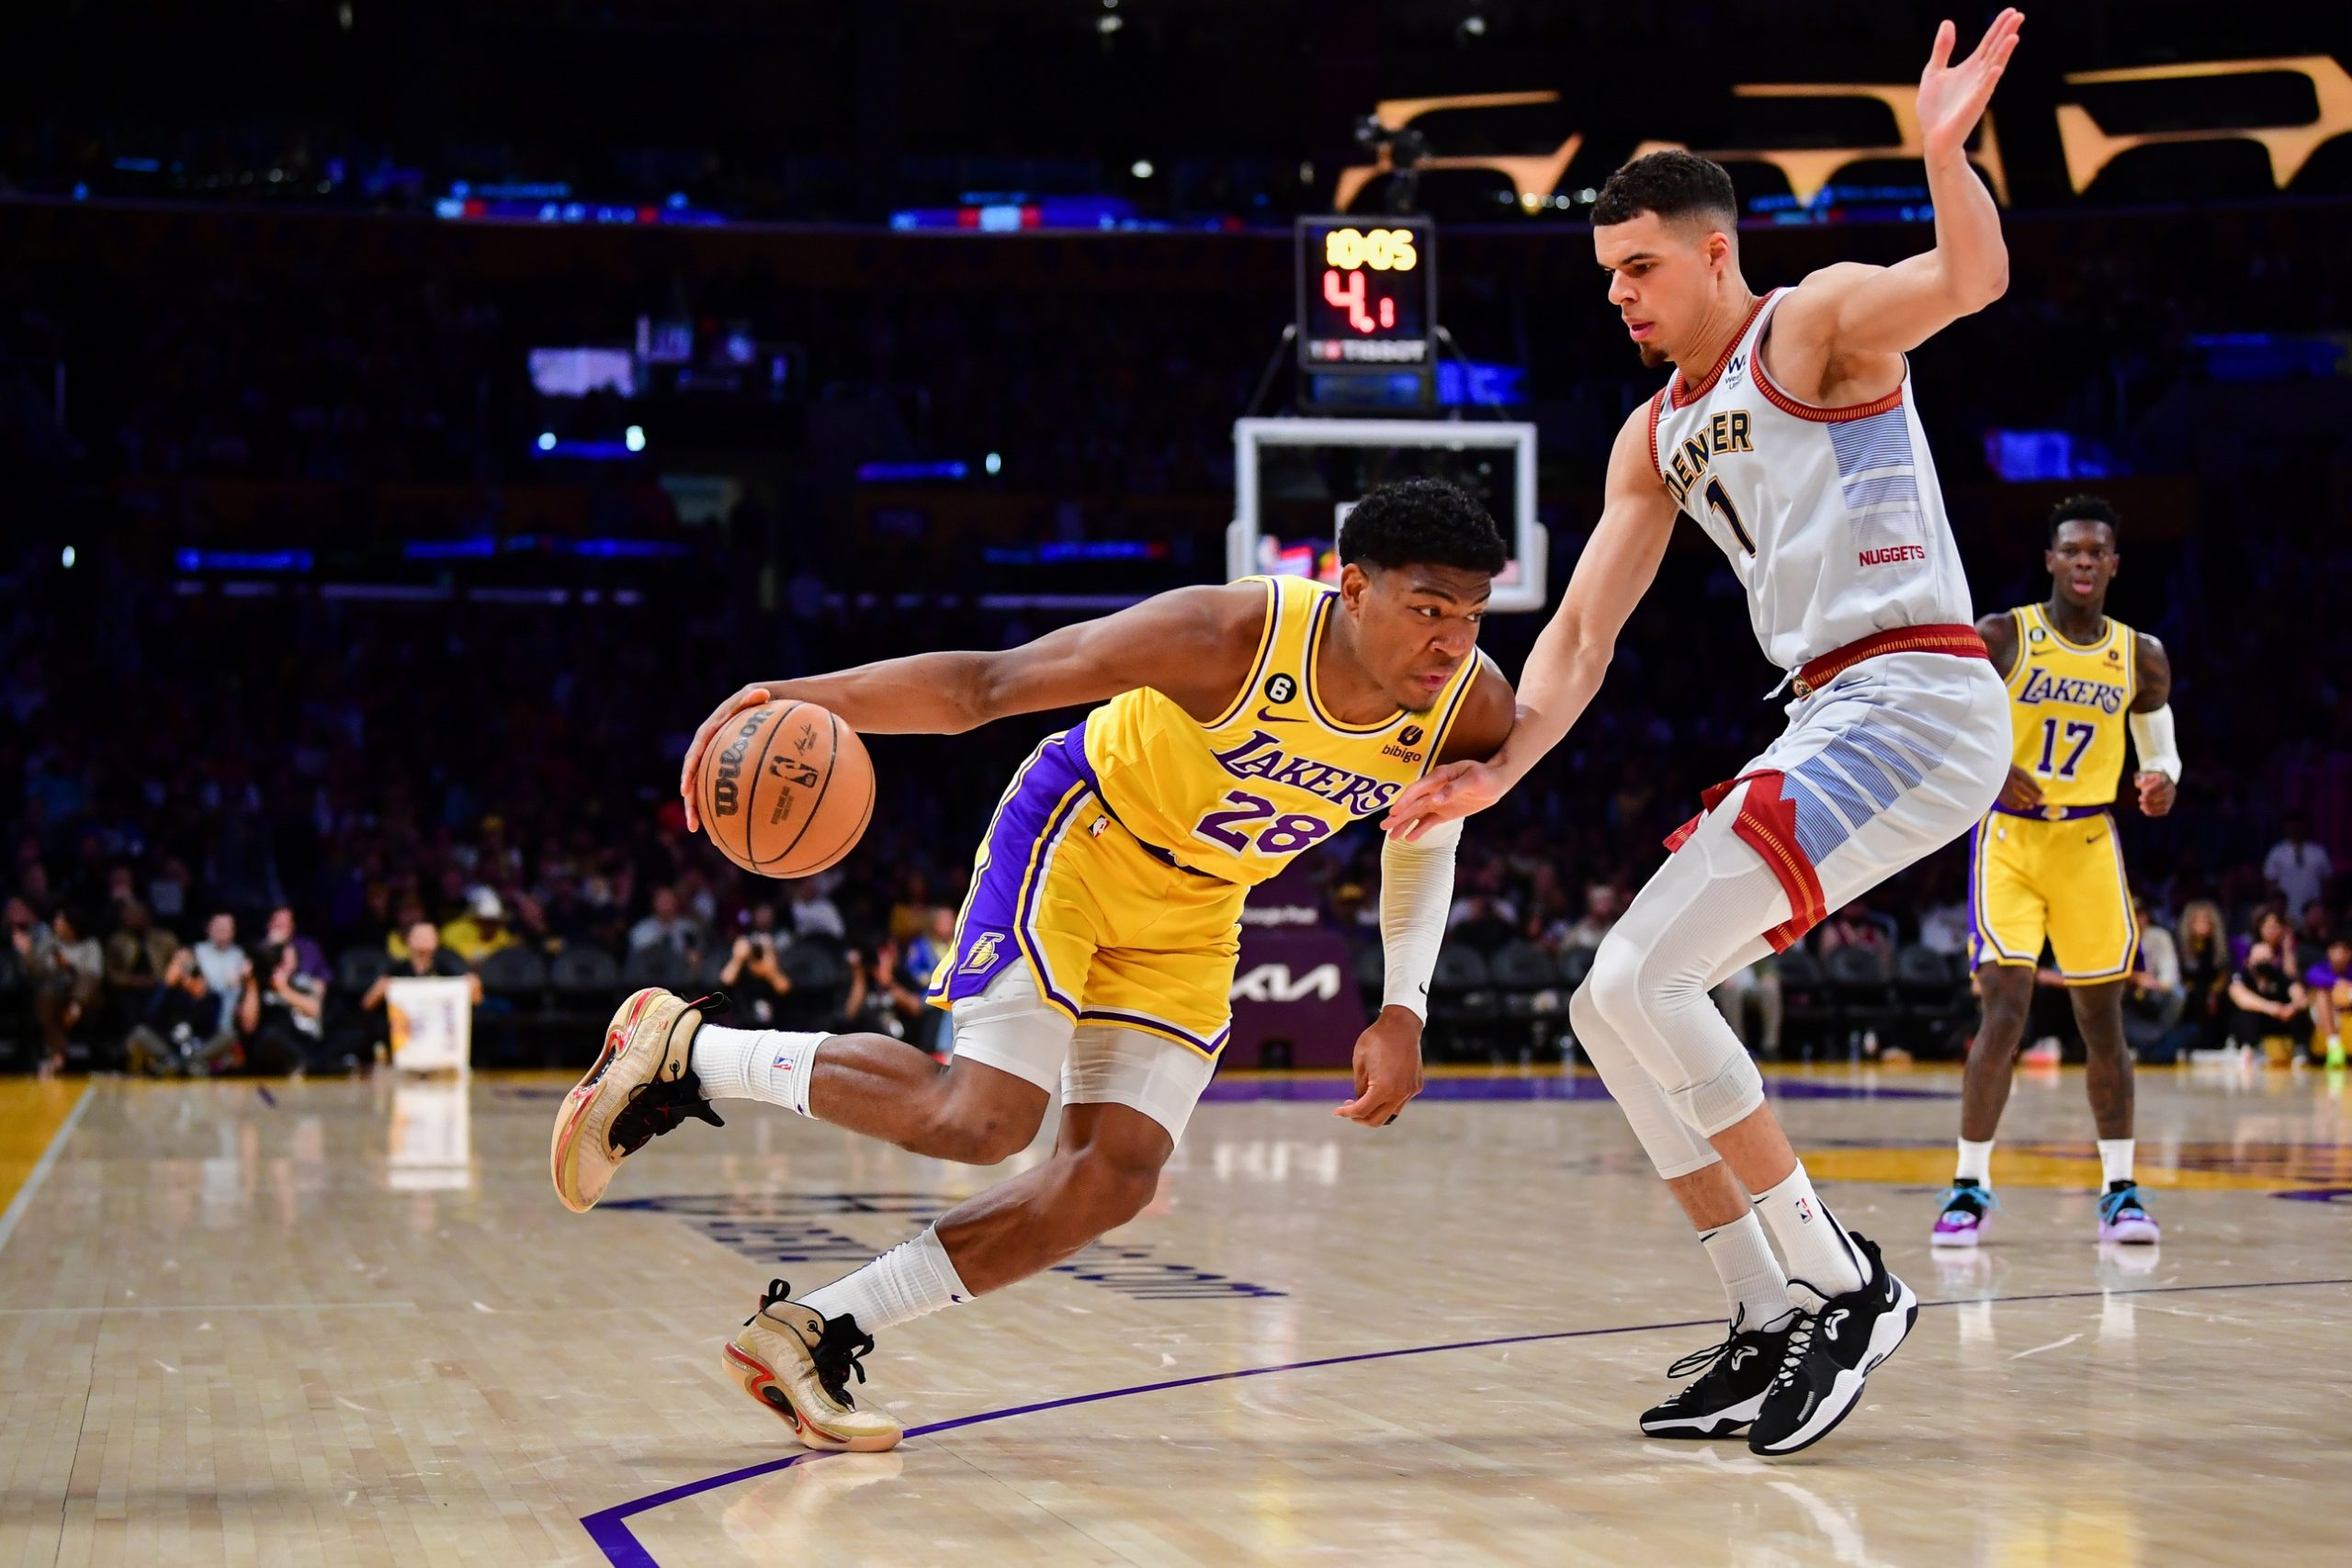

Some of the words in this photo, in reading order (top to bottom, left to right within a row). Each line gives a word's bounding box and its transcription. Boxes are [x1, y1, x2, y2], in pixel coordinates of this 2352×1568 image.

[1663, 409, 1754, 510] DENER
[1703, 475, 1757, 558] 1
[1859, 545, 1925, 567] NUGGETS
[1270, 676, 1292, 702] 6
[2017, 667, 2125, 715] LAKERS
[1209, 729, 1403, 816] LAKERS
[1381, 744, 1422, 763] bibigo
[2037, 718, 2095, 777] 17
[1195, 790, 1331, 855] 28
